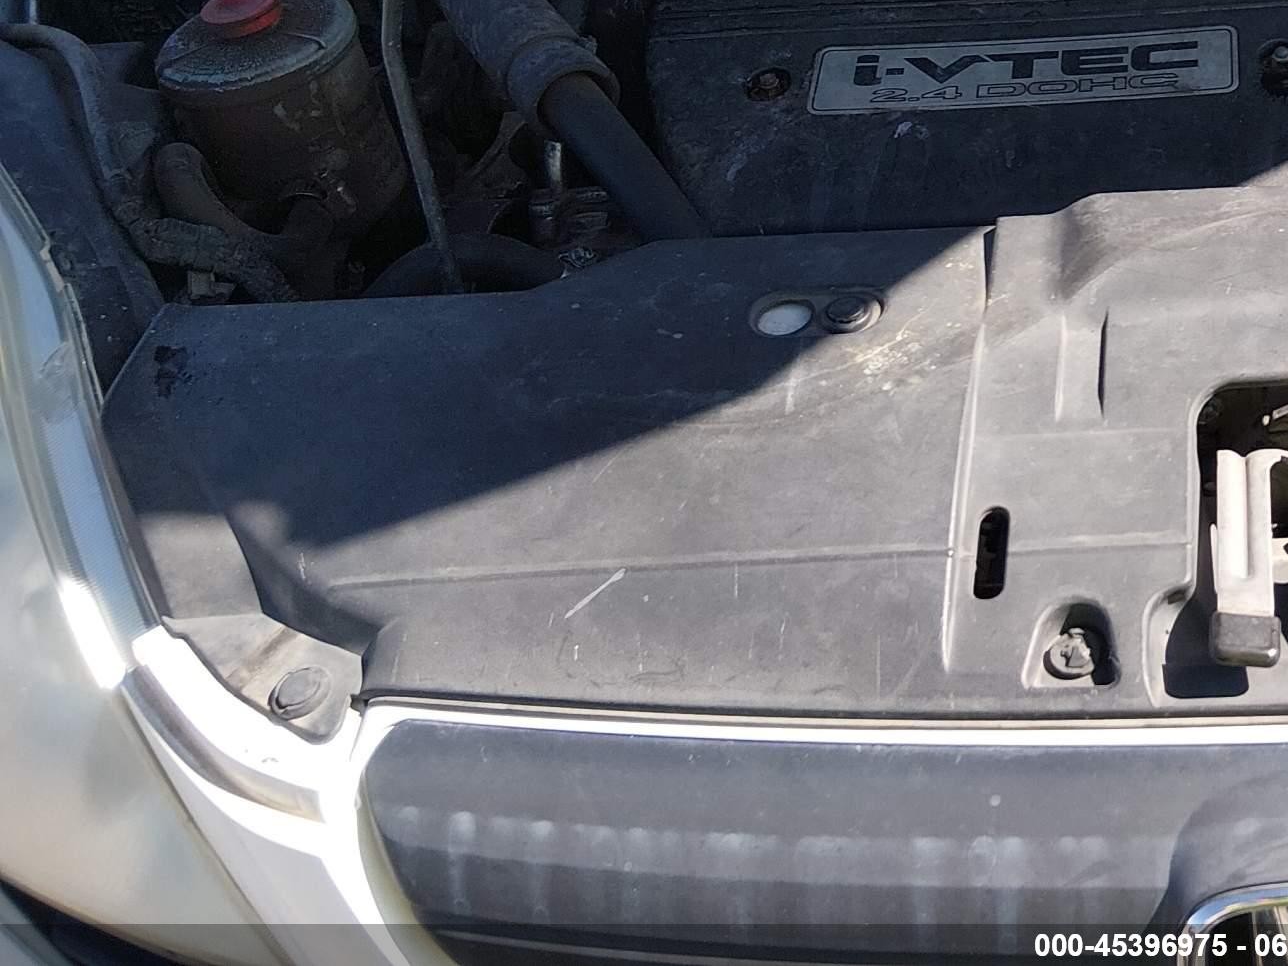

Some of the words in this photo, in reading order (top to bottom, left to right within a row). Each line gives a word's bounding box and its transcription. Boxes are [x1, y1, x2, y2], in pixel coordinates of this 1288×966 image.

[855, 40, 1199, 87] i-VTEC
[870, 85, 963, 103] 2.4
[975, 72, 1180, 98] DOHC
